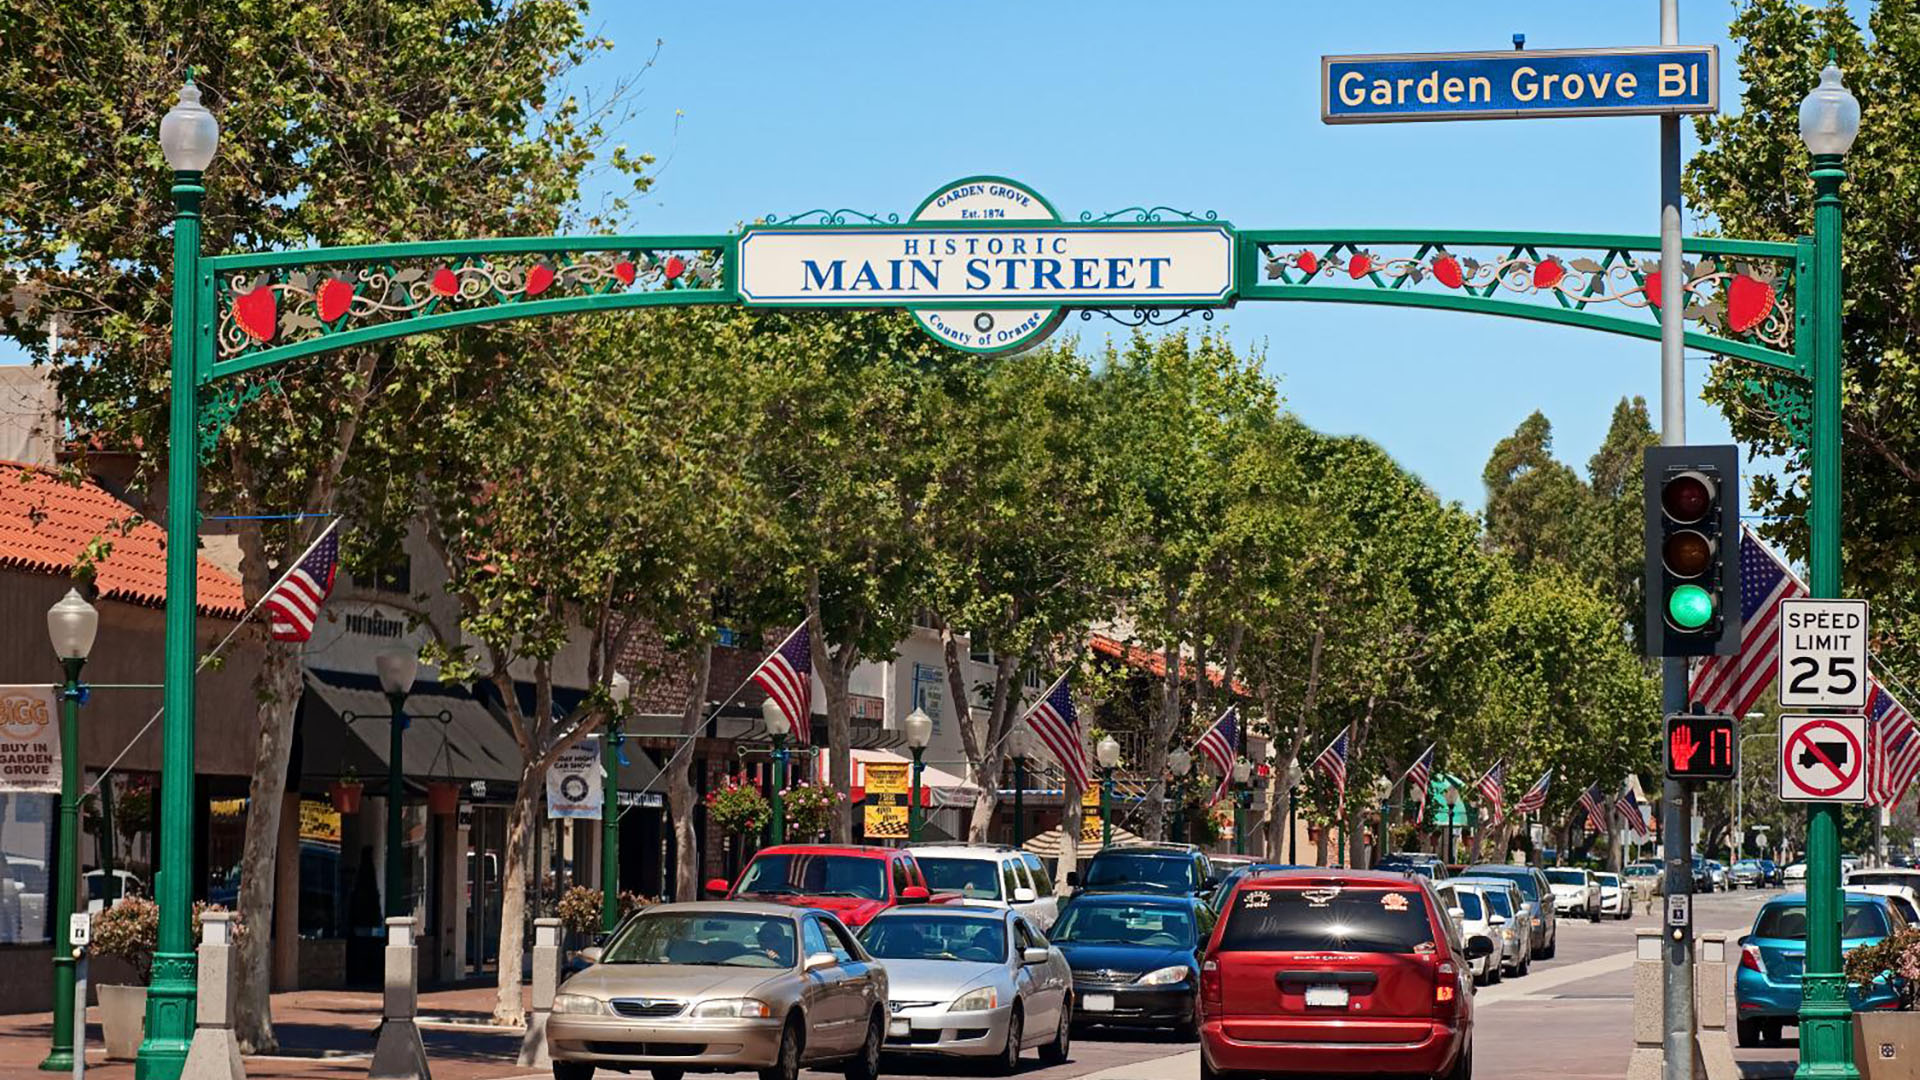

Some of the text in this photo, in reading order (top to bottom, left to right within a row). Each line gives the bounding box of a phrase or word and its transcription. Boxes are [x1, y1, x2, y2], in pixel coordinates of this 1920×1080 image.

[1338, 70, 1492, 107] Garden
[1510, 66, 1639, 102] Grove
[936, 185, 1031, 208] GARDEN GROVE
[961, 208, 1005, 219] Est. 1874
[904, 237, 1068, 256] HISTORIC
[801, 257, 1172, 292] MAIN STREET
[929, 312, 1042, 346] County of Orange
[1788, 613, 1861, 630] SPEED
[1796, 635, 1851, 651] LIMIT
[1789, 656, 1858, 695] 25
[2, 743, 48, 753] BUY IN
[1709, 728, 1732, 767] 17
[0, 754, 53, 765] GARDEN
[4, 765, 50, 775] GROVE
